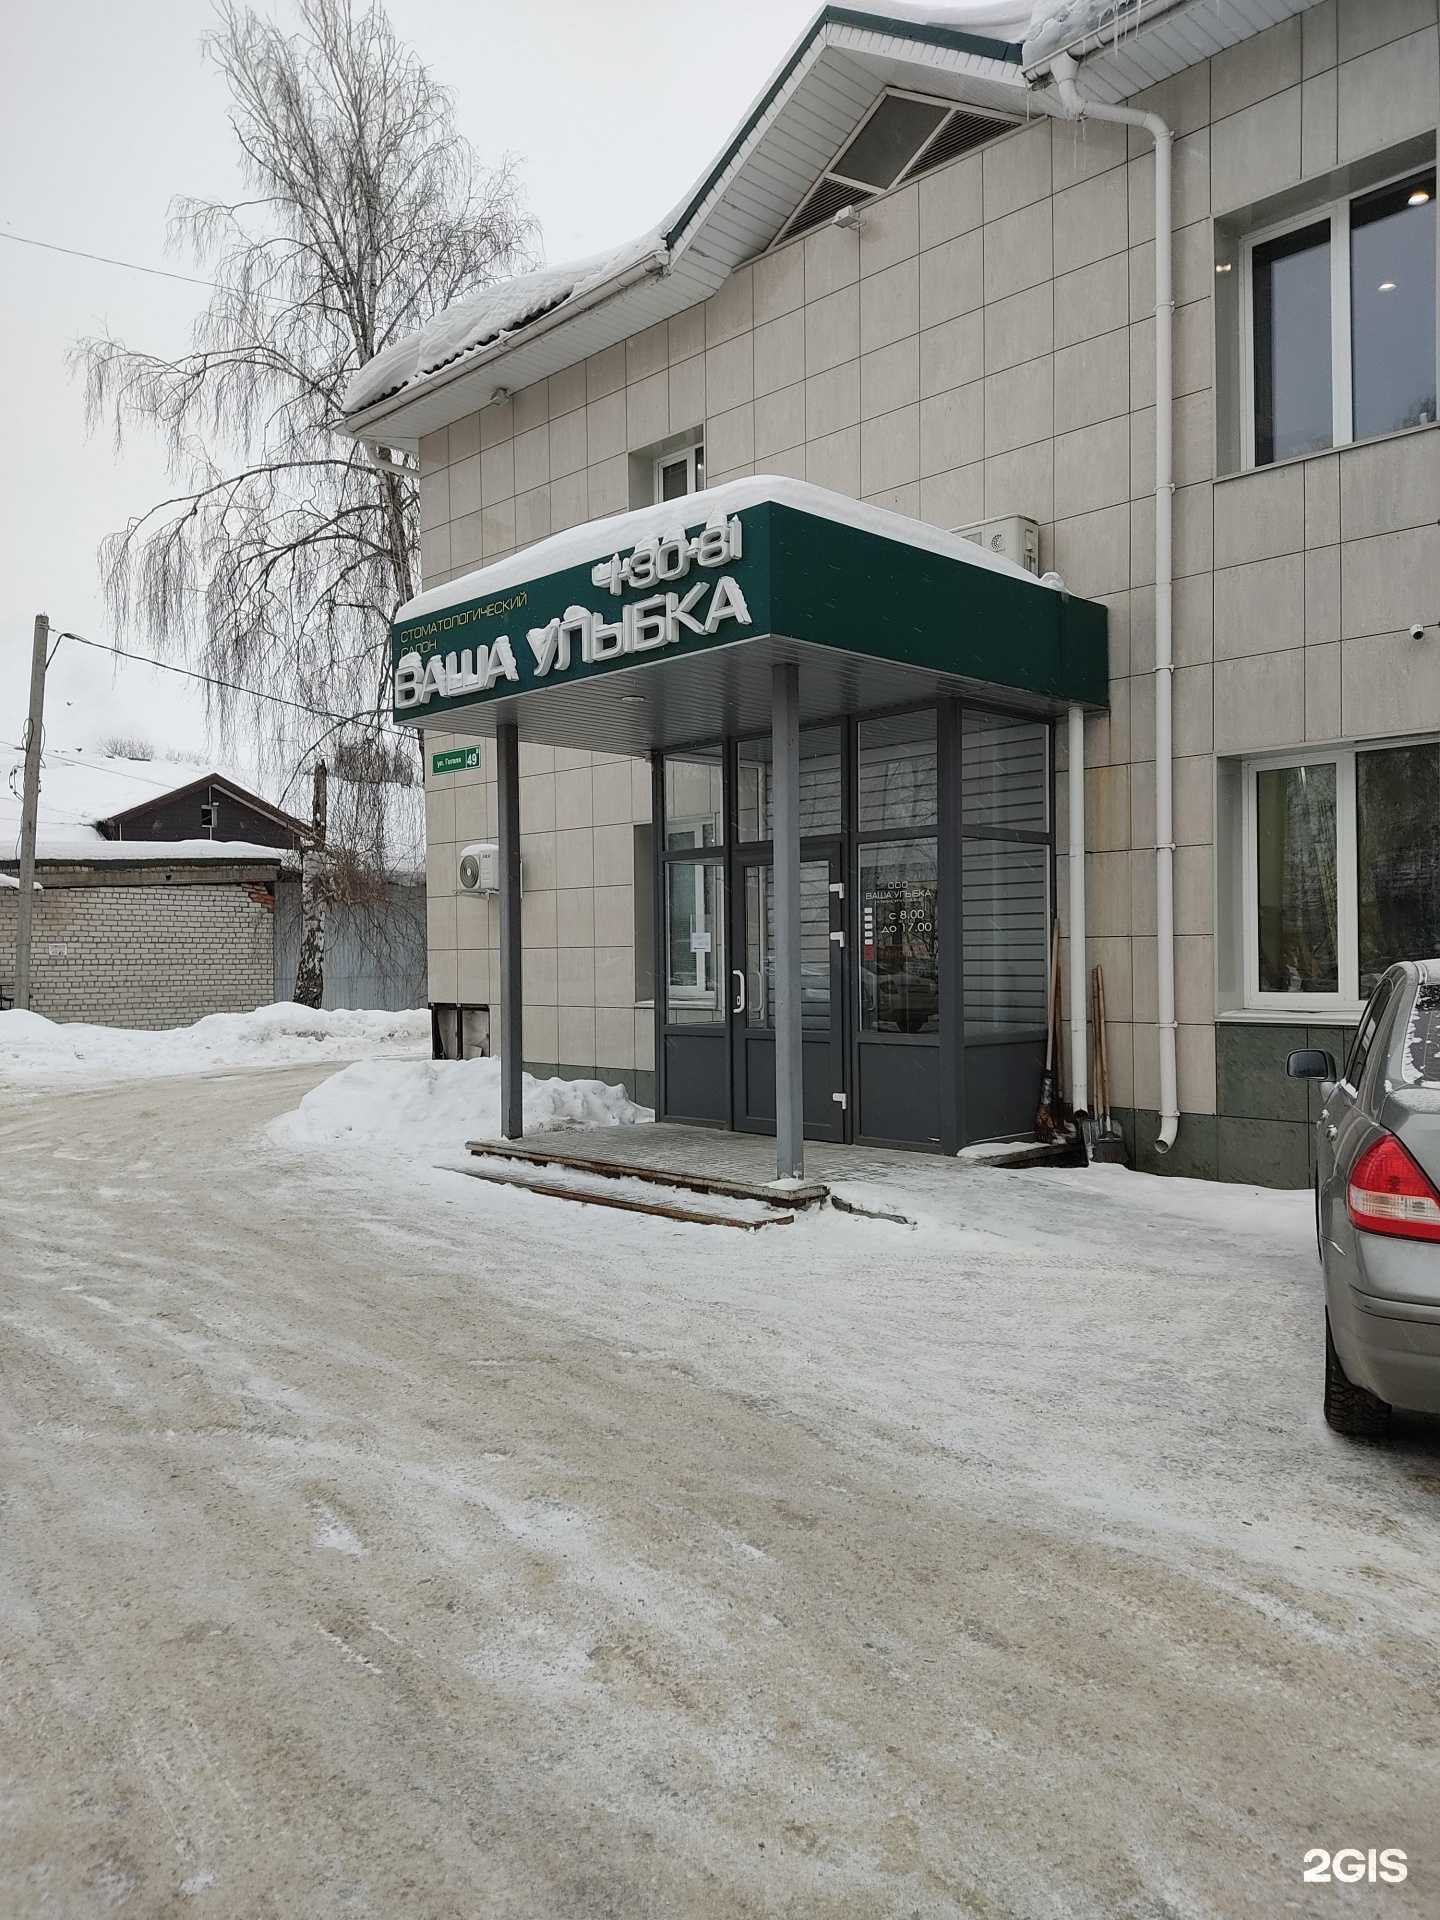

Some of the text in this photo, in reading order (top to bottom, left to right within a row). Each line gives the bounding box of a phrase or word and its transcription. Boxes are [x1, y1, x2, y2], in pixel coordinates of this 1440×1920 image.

[400, 591, 528, 643] СТОМАТОЛОГИЧЕСКИЙ
[395, 575, 753, 709] ВАША УЛЫБКА
[467, 753, 477, 766] 49
[900, 910, 924, 920] 8.00
[902, 922, 932, 932] 17.00
